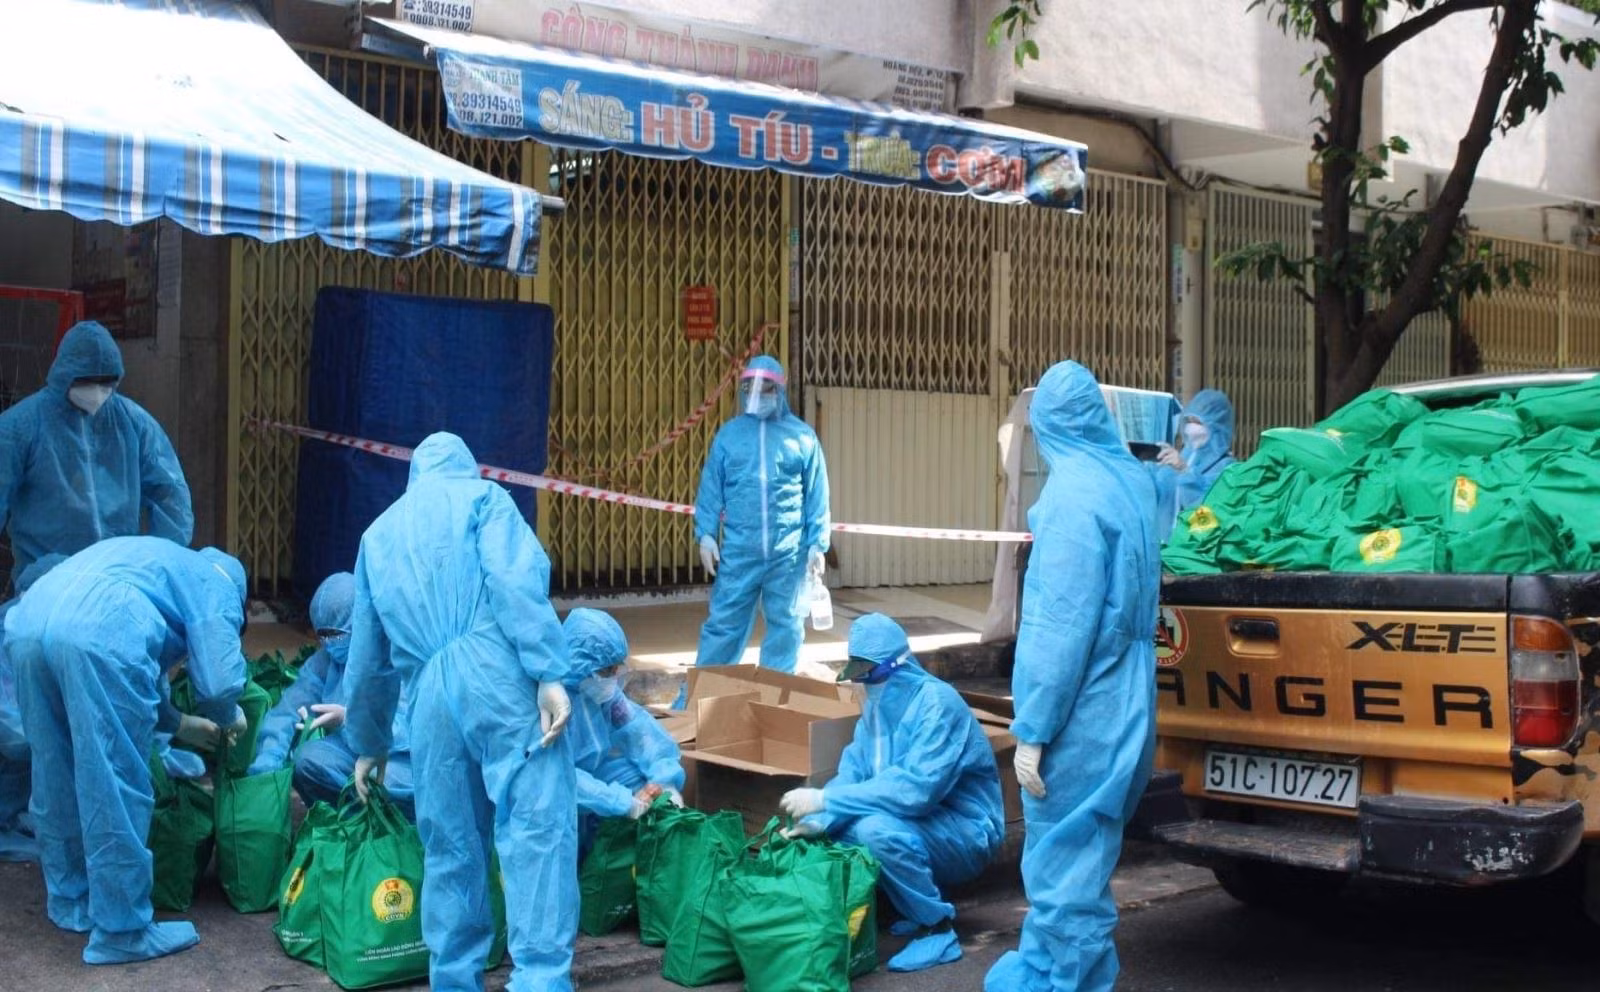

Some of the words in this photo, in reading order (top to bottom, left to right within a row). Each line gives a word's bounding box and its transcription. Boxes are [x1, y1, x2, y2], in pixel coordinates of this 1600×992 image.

[459, 109, 523, 126] 08.121.002
[641, 92, 715, 152] HỦ
[730, 109, 813, 165] TÍU
[926, 144, 1027, 194] CƠM
[1346, 621, 1476, 654] XLT
[1157, 668, 1494, 729] ANGER
